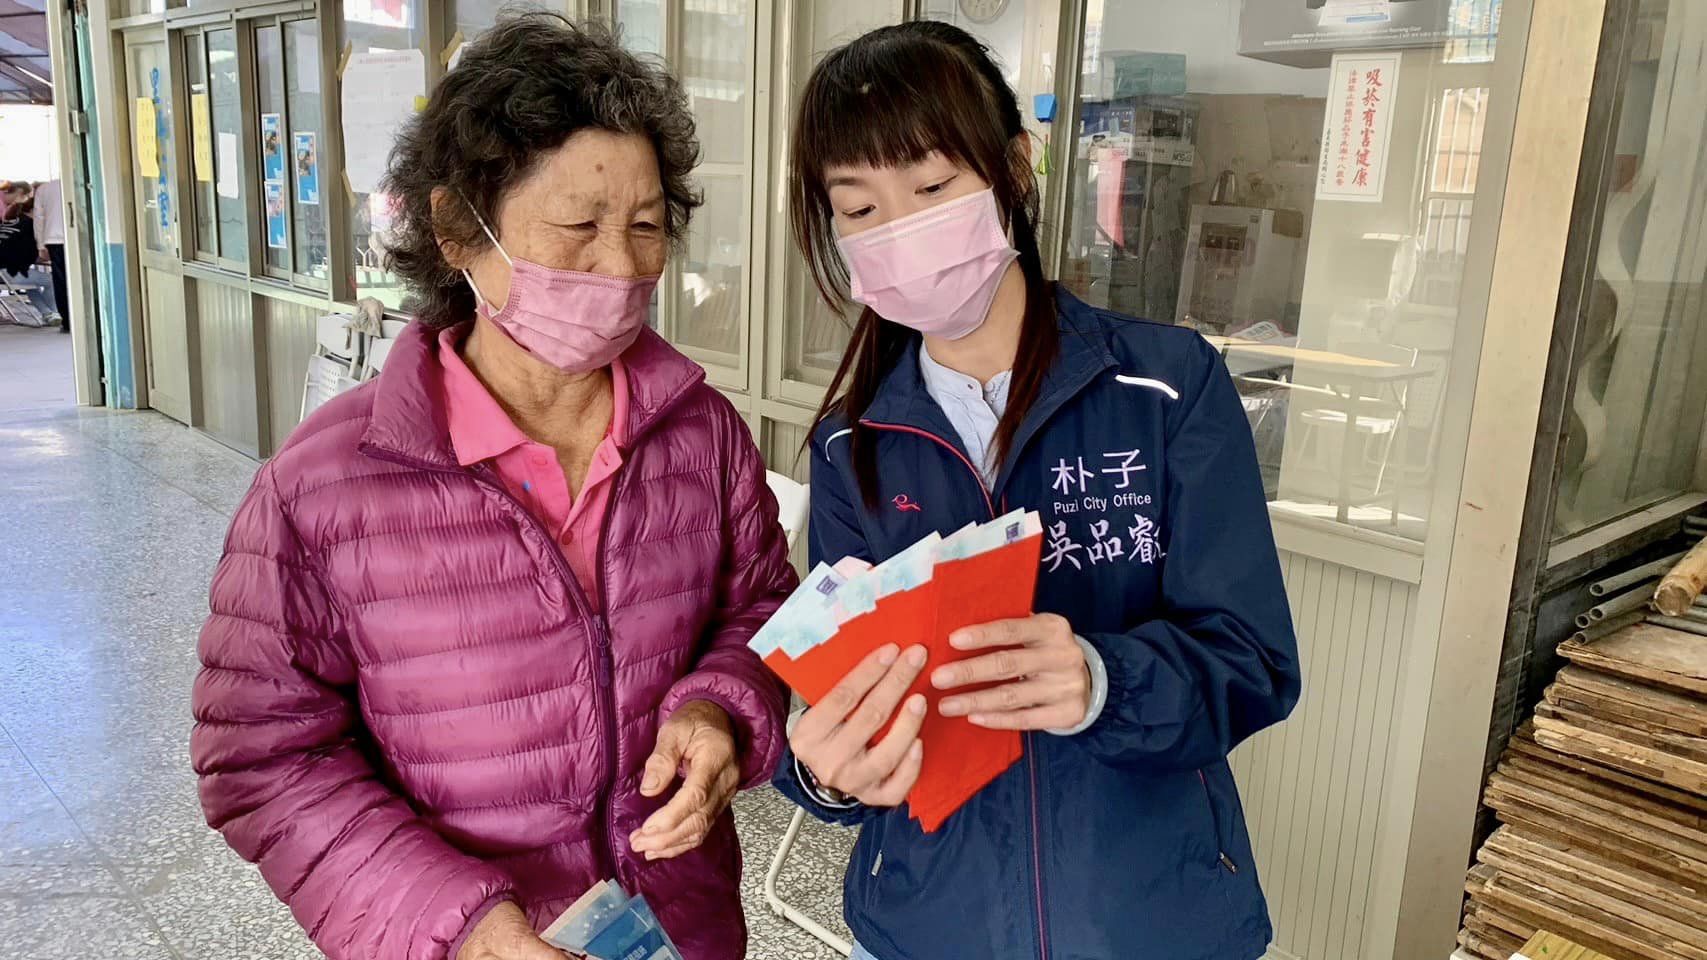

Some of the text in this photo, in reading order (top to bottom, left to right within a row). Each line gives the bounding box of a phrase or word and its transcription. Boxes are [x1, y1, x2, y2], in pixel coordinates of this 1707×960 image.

[1351, 67, 1383, 187] 吸菸有害健康
[1051, 449, 1147, 495] 朴子
[1053, 492, 1152, 515] Puzi City Office
